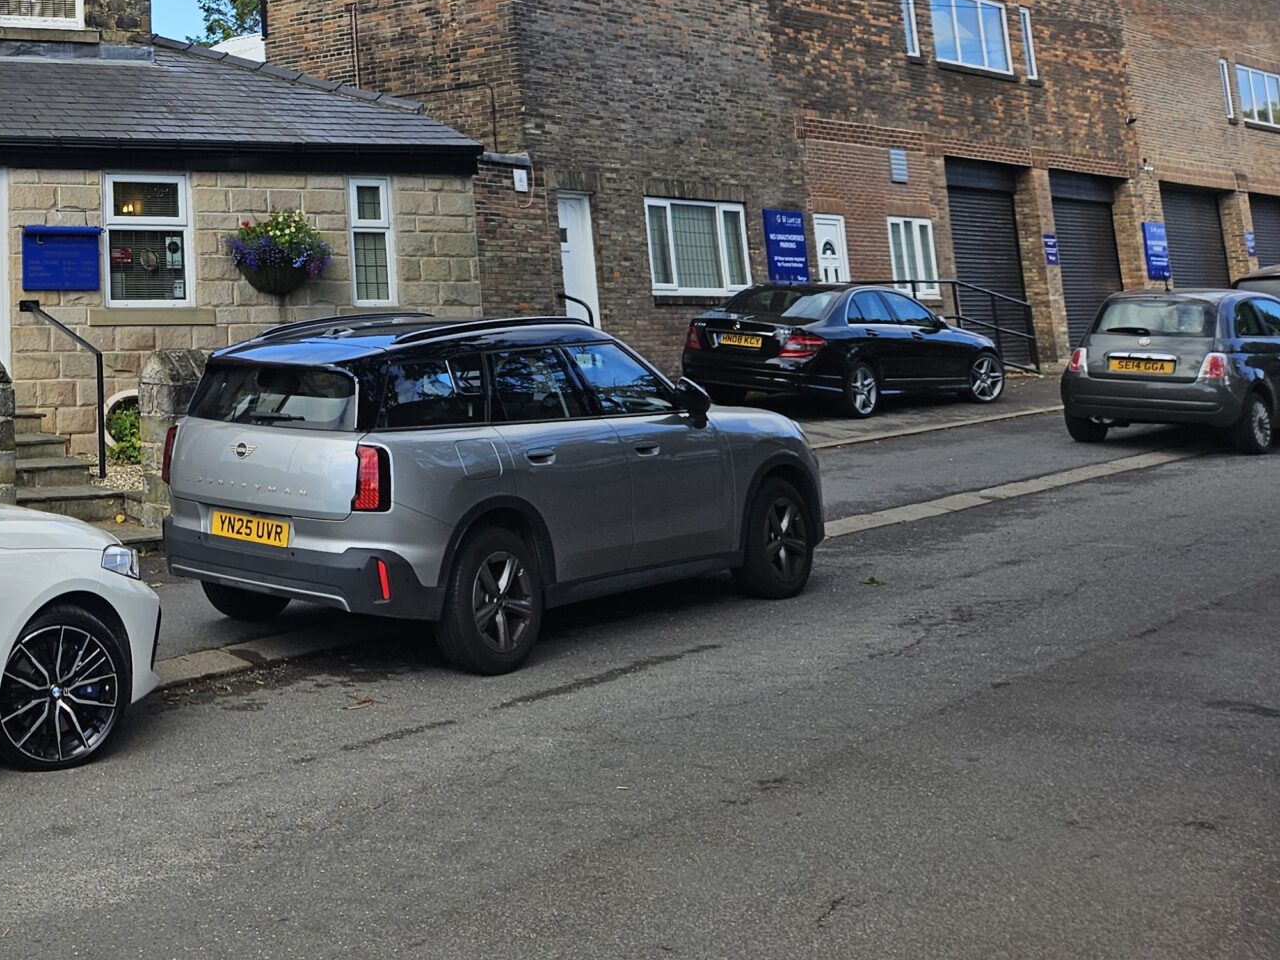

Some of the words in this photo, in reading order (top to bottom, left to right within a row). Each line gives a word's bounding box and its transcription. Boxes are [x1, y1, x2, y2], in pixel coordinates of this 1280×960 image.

[1117, 360, 1140, 370] SE14
[1144, 362, 1165, 371] GGA
[220, 514, 253, 537] YN25
[256, 521, 283, 542] UVR
